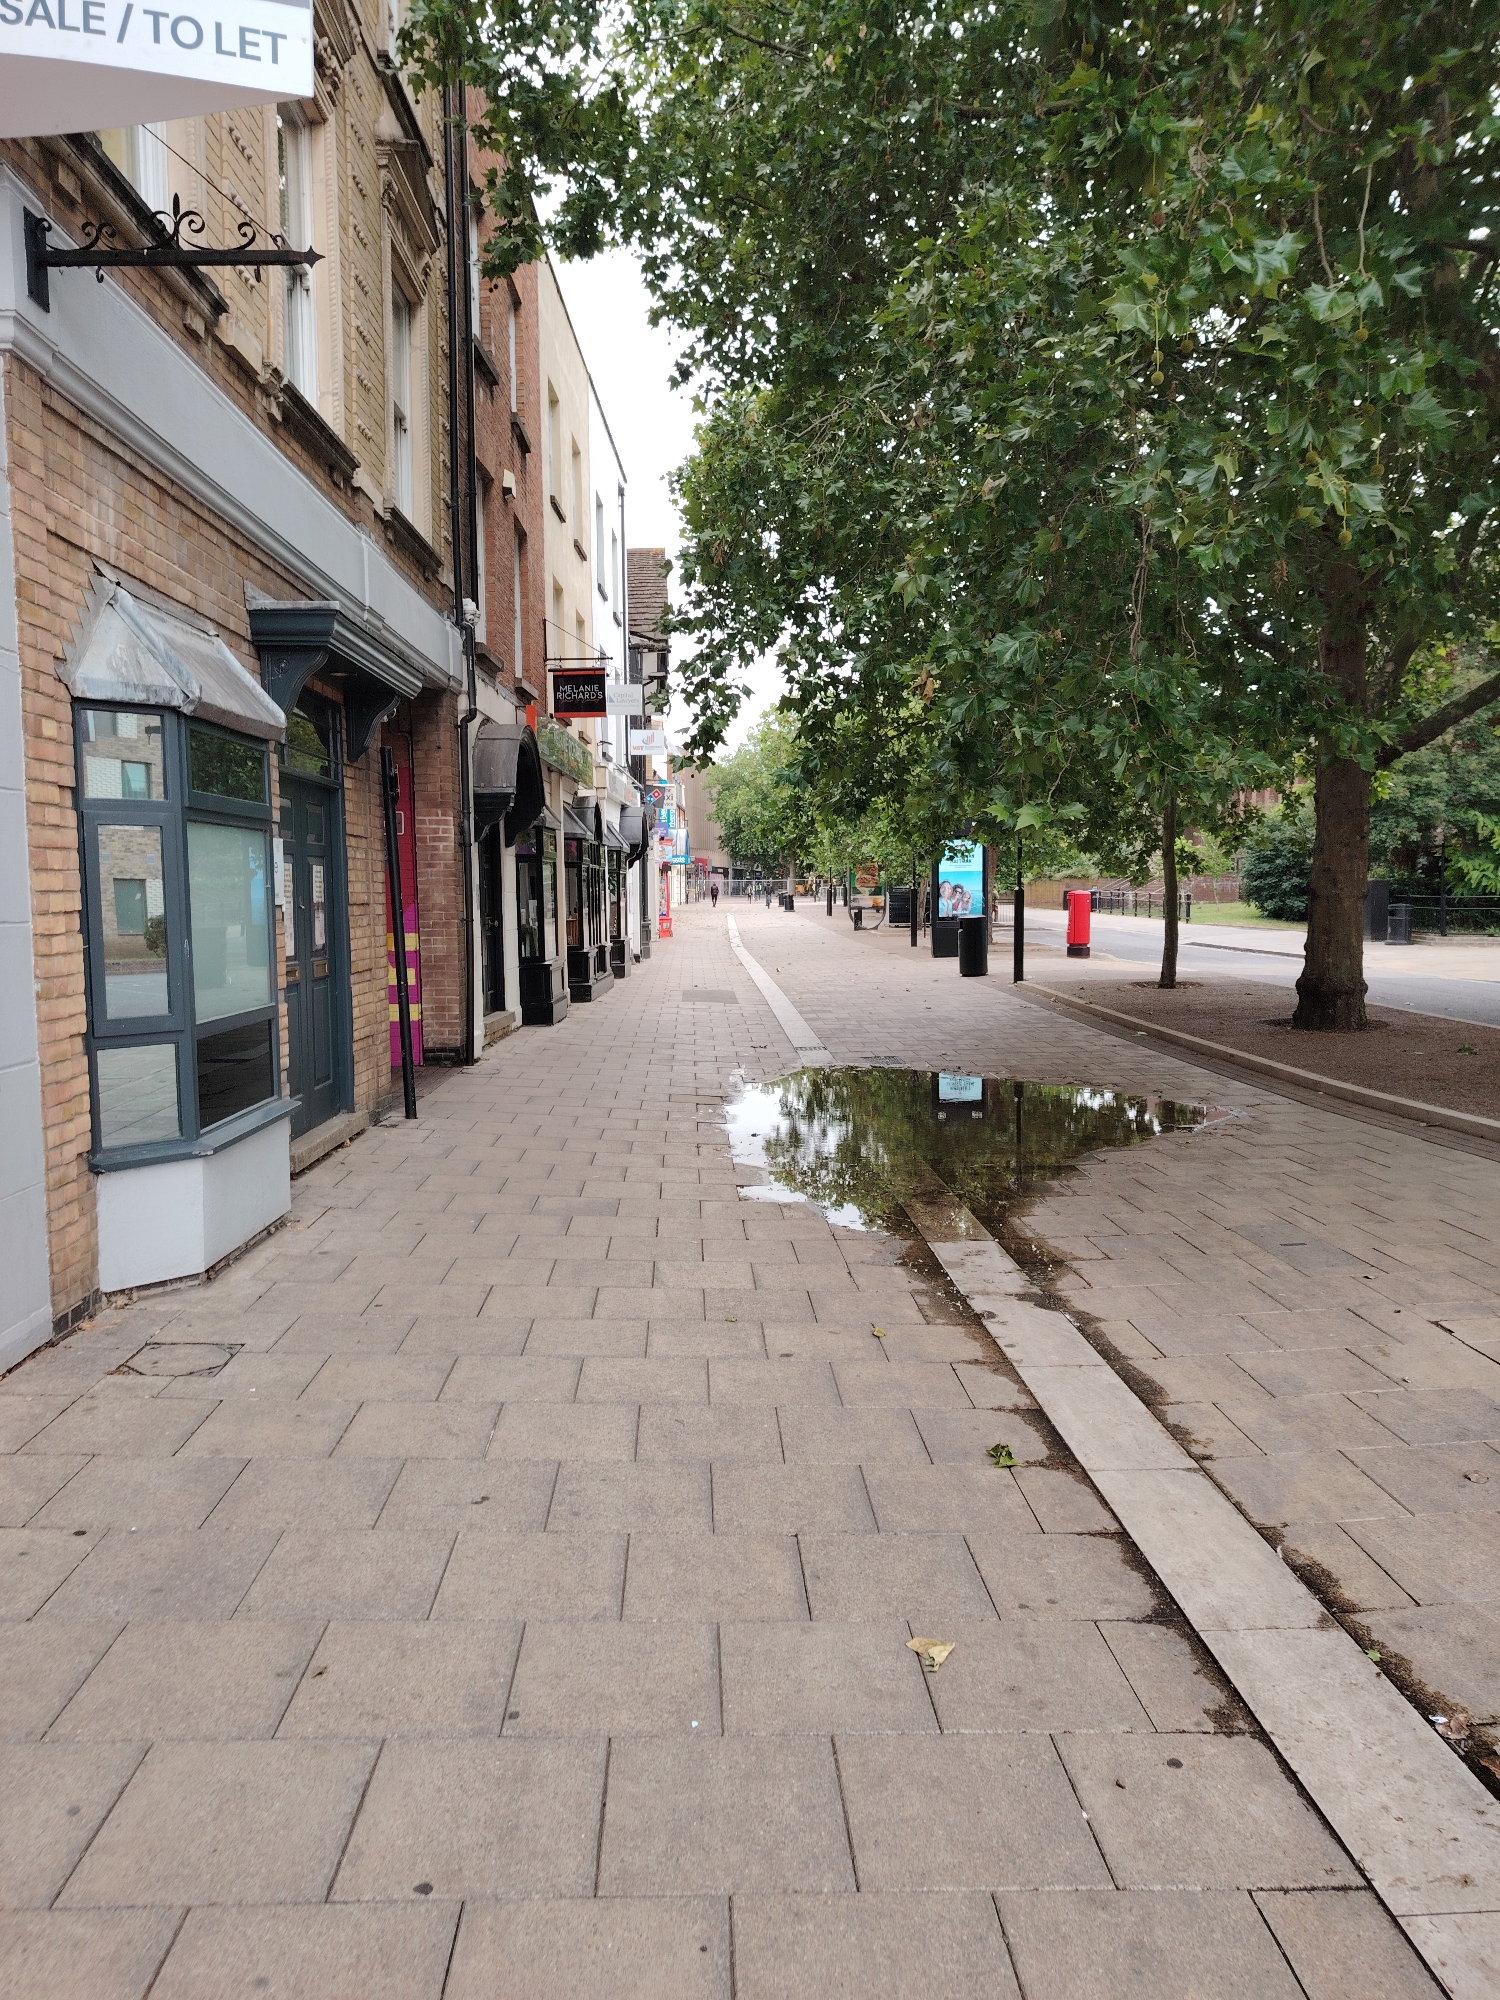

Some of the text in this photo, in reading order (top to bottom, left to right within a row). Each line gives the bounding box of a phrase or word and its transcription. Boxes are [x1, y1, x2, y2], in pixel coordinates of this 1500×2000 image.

[0, 0, 106, 36] SALE
[143, 9, 204, 50] TO
[215, 21, 288, 65] LET
[559, 684, 600, 692] MELANIE
